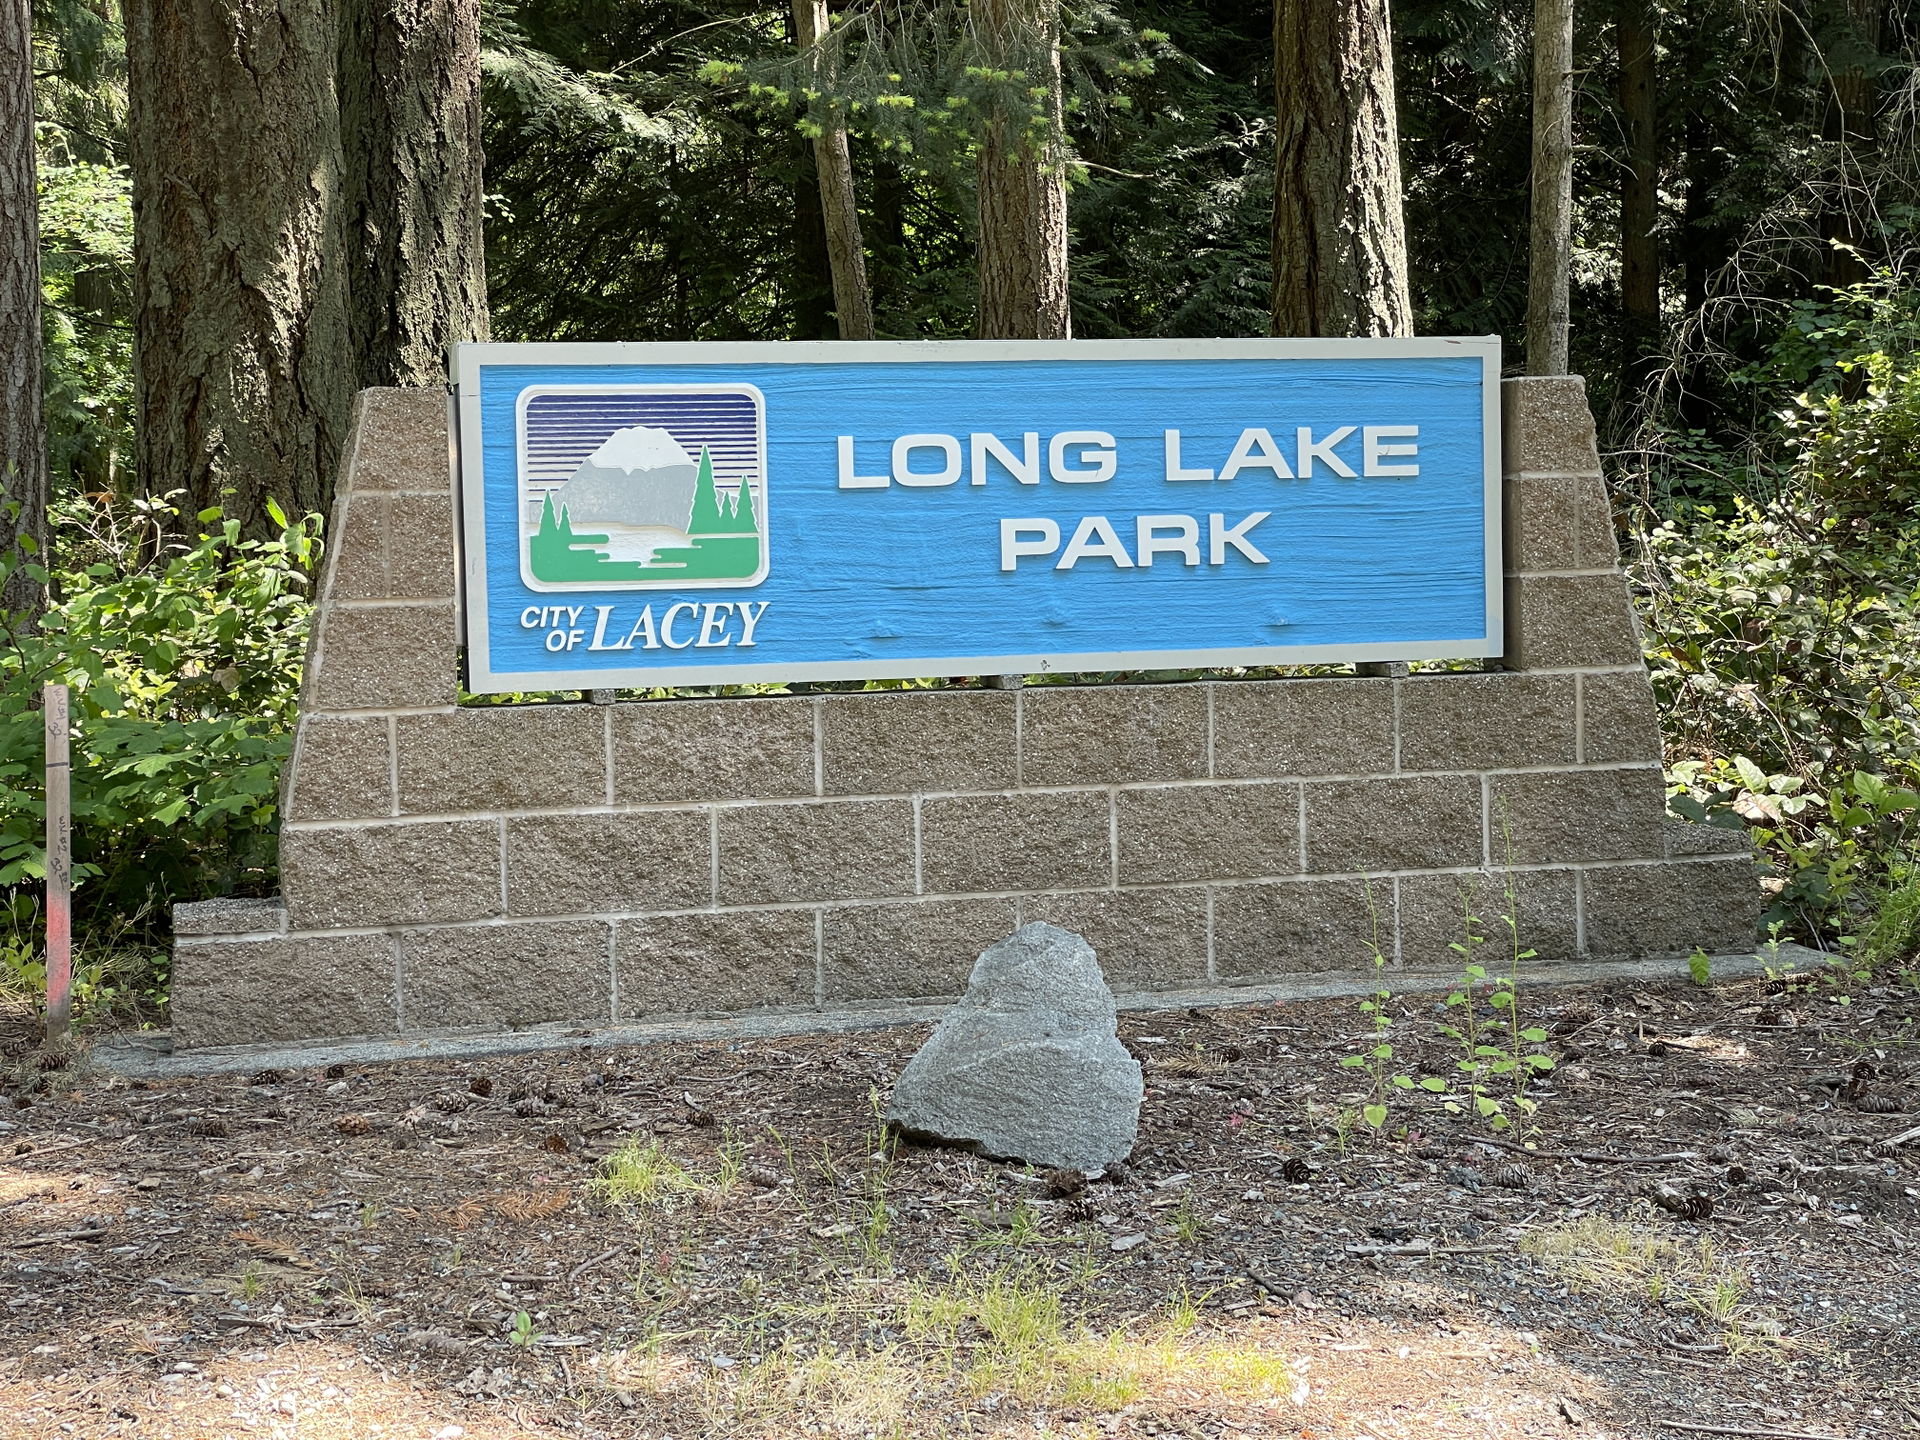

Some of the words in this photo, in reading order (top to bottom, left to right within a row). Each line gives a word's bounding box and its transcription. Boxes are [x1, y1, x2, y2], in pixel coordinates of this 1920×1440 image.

[837, 430, 1117, 489] LONG
[1164, 424, 1420, 481] LAKE
[1000, 511, 1272, 571] PARK
[520, 605, 584, 629] CITY
[545, 629, 585, 652] OF
[587, 601, 771, 651] LACEY
